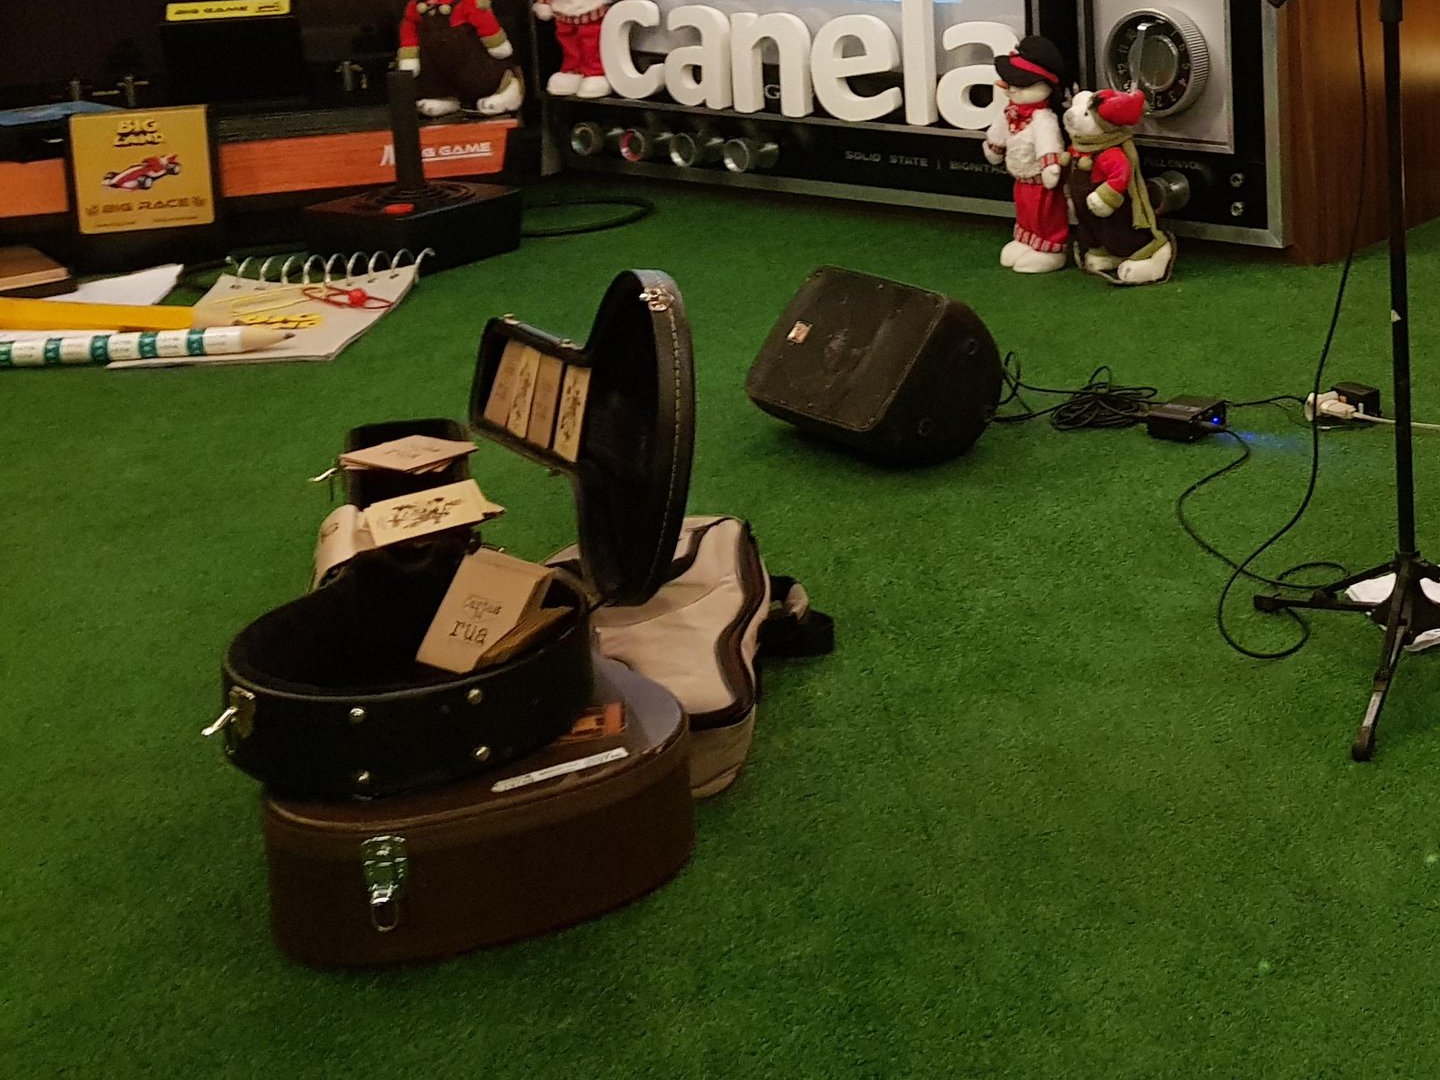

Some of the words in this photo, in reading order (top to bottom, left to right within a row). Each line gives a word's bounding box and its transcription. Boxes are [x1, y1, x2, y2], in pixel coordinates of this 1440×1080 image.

[438, 141, 492, 156] GAME
[845, 150, 881, 163] SOLID
[889, 155, 929, 168] STATE
[101, 202, 133, 214] BIG
[138, 198, 189, 211] RACE
[448, 620, 489, 647] rua
